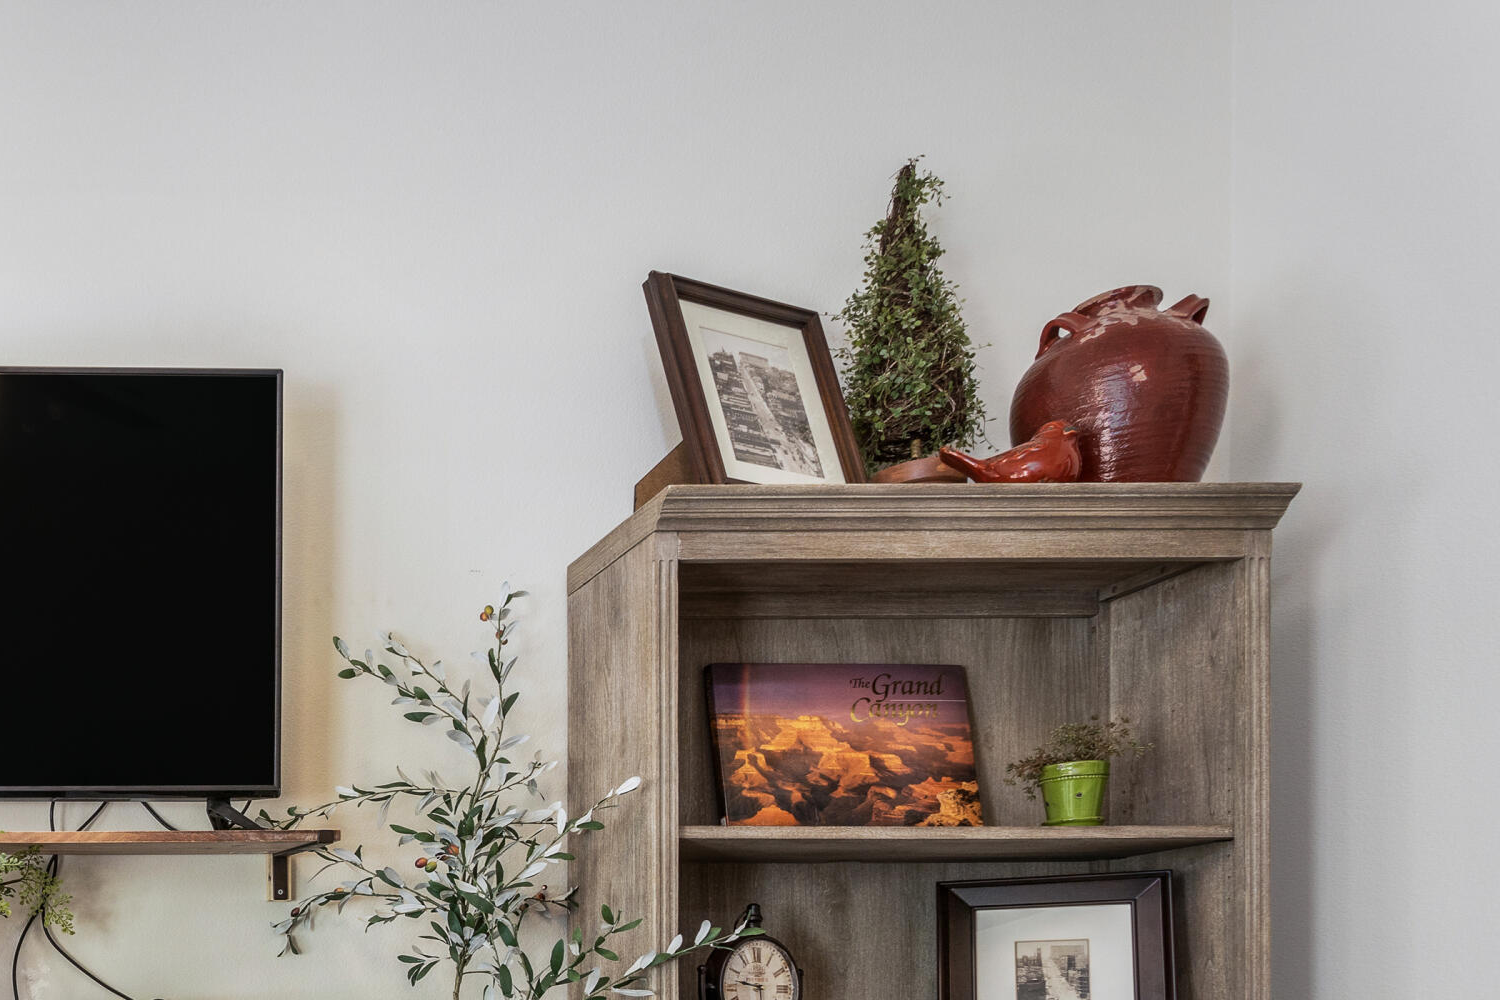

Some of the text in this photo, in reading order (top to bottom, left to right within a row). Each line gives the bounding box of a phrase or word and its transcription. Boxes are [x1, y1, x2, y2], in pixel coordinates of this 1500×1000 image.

[852, 673, 945, 702] The Grand
[850, 697, 939, 726] Canyon
